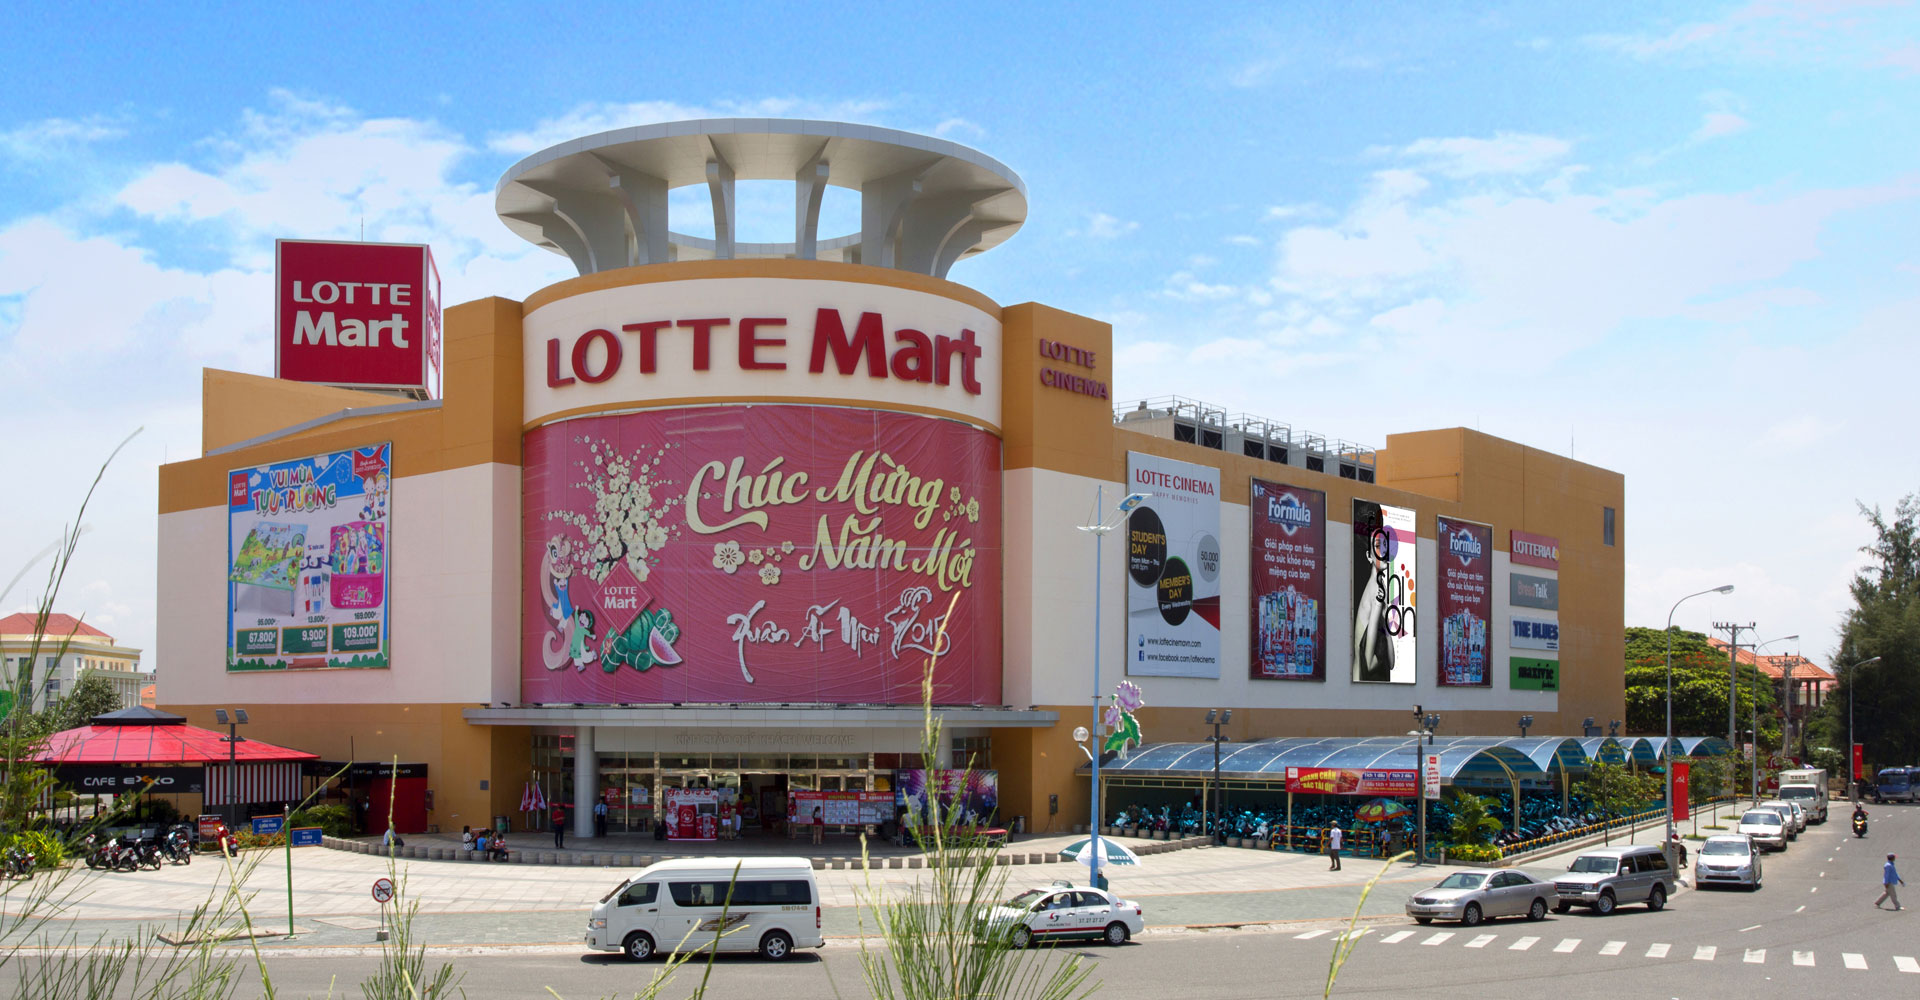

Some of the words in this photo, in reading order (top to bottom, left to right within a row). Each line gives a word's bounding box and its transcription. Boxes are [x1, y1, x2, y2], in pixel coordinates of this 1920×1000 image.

[293, 280, 411, 306] LOTTE
[292, 310, 409, 349] Mart
[547, 317, 787, 389] LOTTE
[808, 307, 983, 396] Mart
[1040, 338, 1097, 369] LOTTE
[1040, 367, 1110, 401] CINEMA
[685, 455, 809, 534] Chúc
[815, 449, 945, 531] Mừng
[1136, 468, 1172, 489] LOTTE
[1172, 475, 1215, 497] CINEMA
[1268, 496, 1311, 523] Formula
[1131, 530, 1166, 546] STUDENT'S
[1131, 543, 1148, 555] DAY
[1449, 532, 1482, 555] Formula
[799, 513, 909, 571] Năm
[911, 526, 977, 592] Mới
[1512, 540, 1552, 560] LOTTERIA
[1203, 562, 1217, 572] VND
[604, 586, 638, 596] LOTTE
[1159, 575, 1191, 589] MEMBER'S
[604, 597, 638, 609] Mart
[1168, 588, 1183, 599] DAY
[1513, 620, 1531, 638] THE
[1531, 622, 1559, 641] BLUES
[726, 600, 791, 684] Xuân
[802, 734, 857, 745] WELCOME
[83, 776, 116, 786] CAFE
